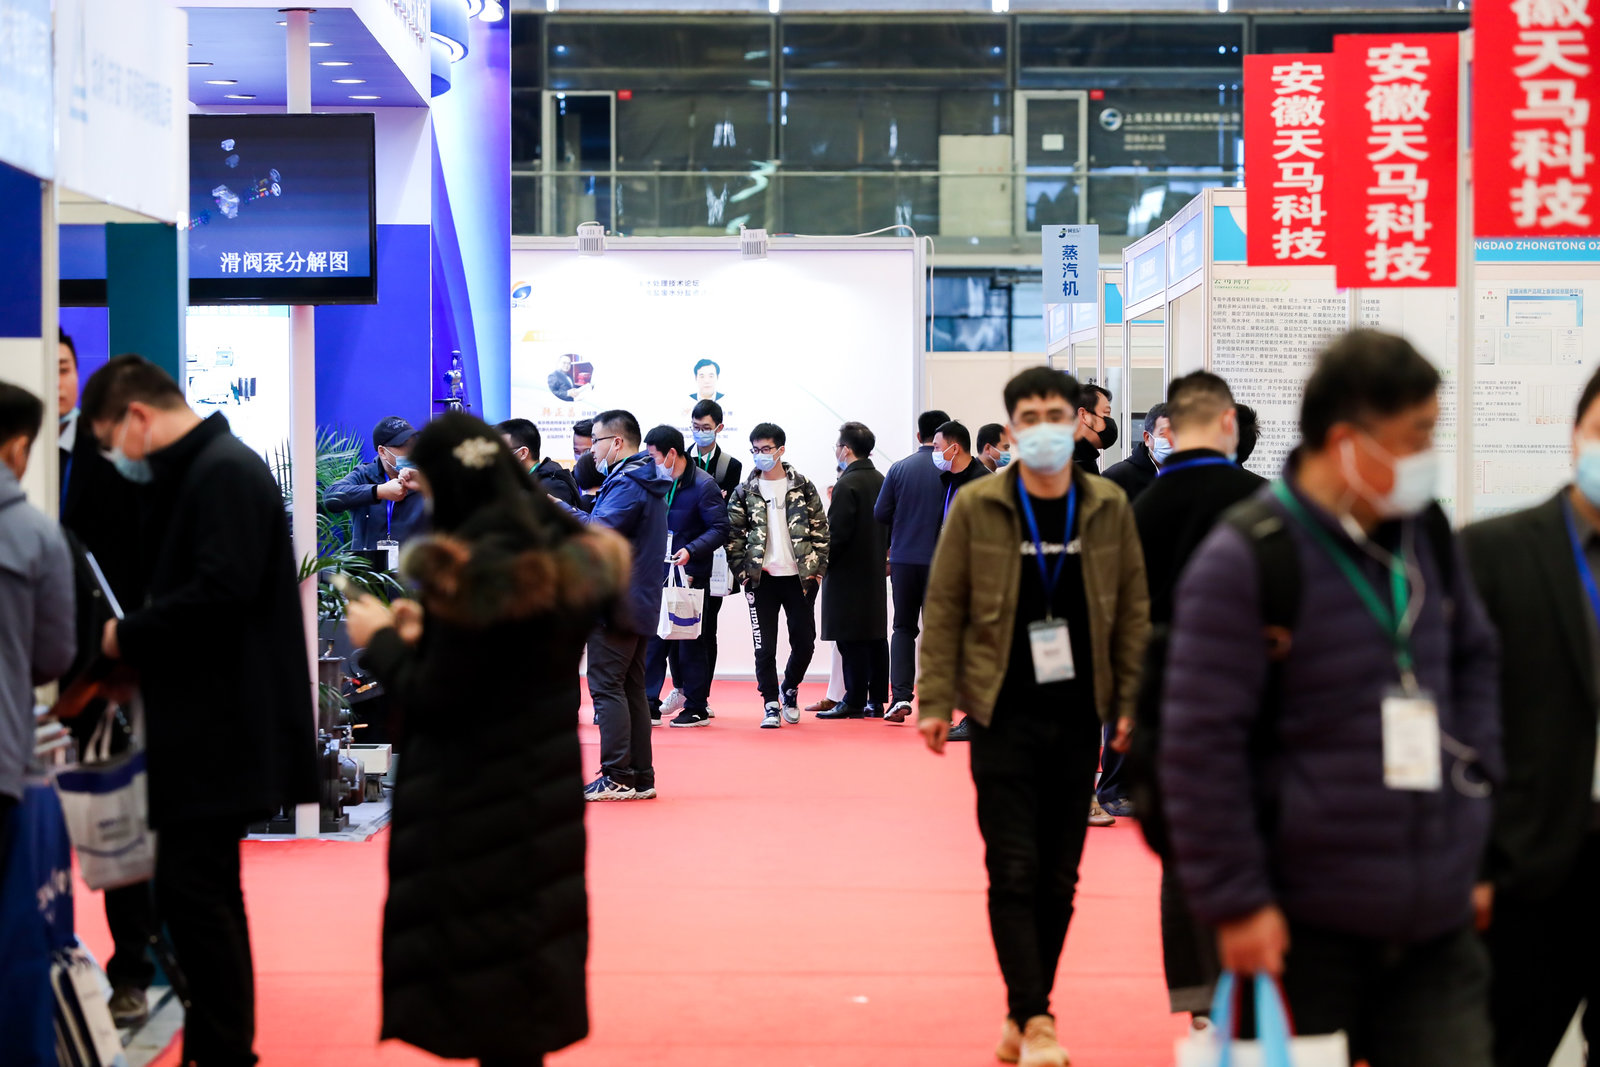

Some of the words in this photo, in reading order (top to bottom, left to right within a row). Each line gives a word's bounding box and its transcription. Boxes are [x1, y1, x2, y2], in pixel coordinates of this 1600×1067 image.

[1271, 61, 1327, 260] 安徽天马科技
[1365, 42, 1433, 281] 安徽天马科技
[220, 250, 349, 273] 滑阀泵分解图
[1474, 241, 1514, 250] NGDAO
[1516, 241, 1586, 250] ZHONGTONG
[1062, 244, 1079, 297] 蒸汽机
[750, 606, 762, 650] HIPANDA
